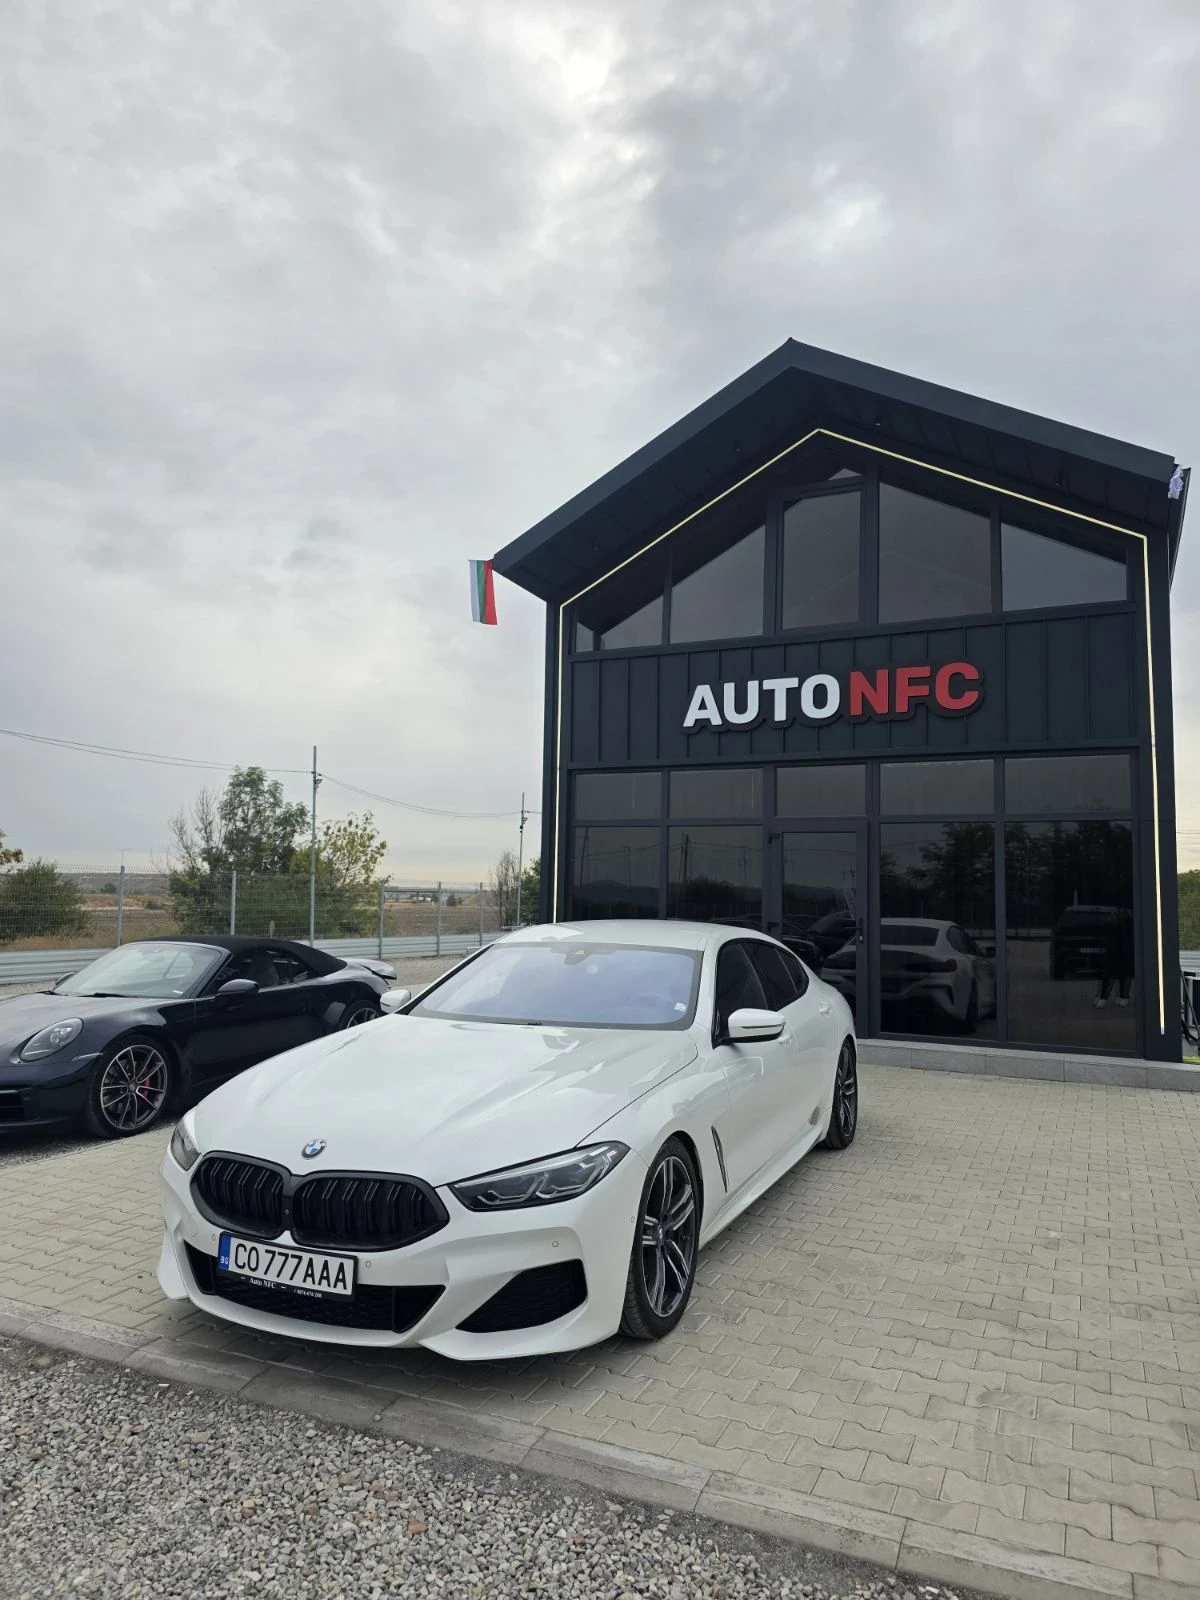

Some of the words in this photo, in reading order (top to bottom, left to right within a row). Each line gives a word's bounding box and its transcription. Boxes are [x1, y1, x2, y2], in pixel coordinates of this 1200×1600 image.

[683, 673, 840, 727] AUTO
[850, 662, 980, 716] NFC
[220, 1255, 229, 1265] BG
[263, 1279, 277, 1289] NFC
